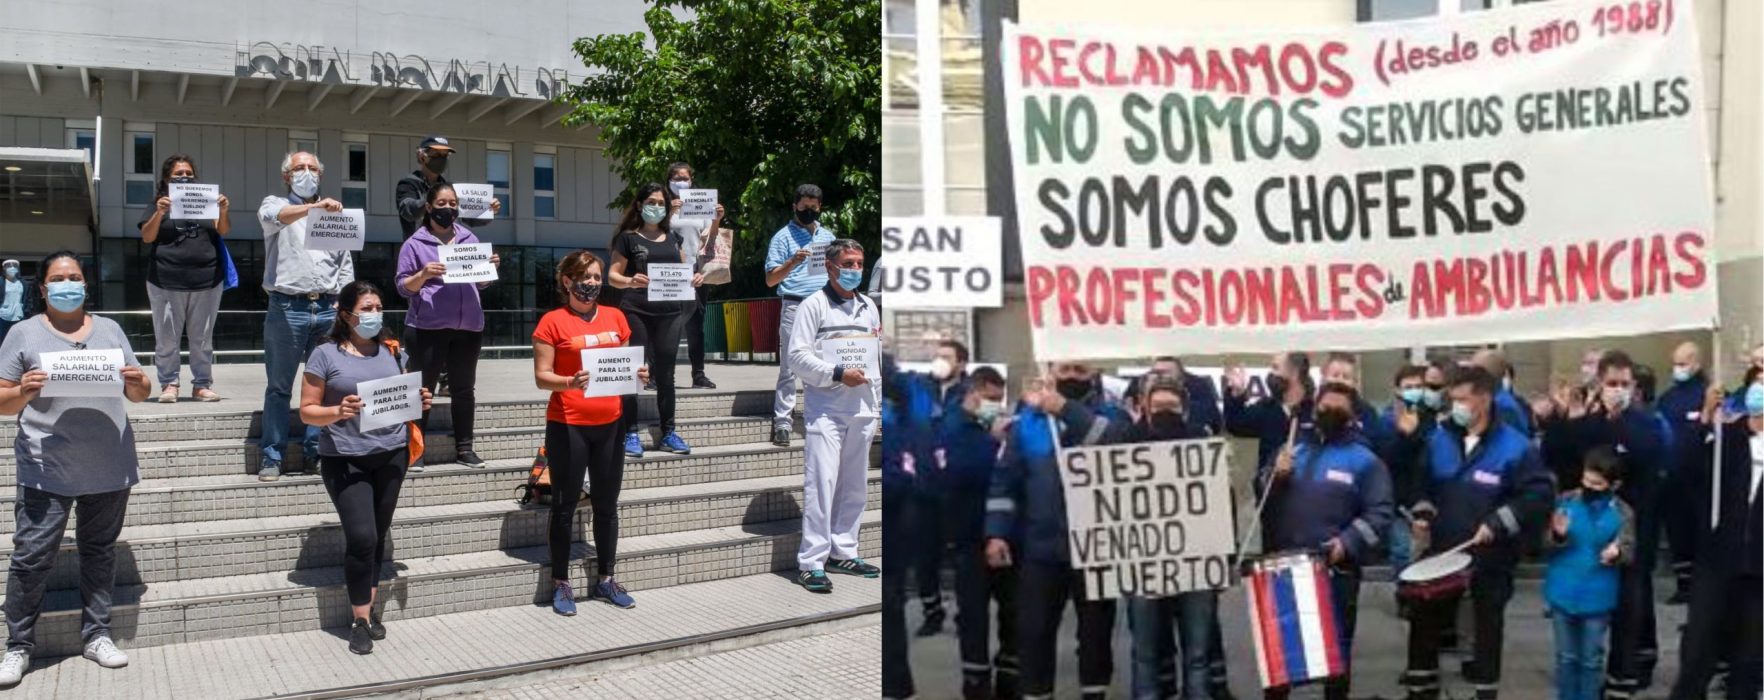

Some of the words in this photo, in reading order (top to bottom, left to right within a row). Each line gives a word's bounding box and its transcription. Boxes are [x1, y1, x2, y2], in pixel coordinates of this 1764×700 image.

[1018, 35, 1354, 98] RECLAMAMOS
[1373, 31, 1478, 85] (desde
[1490, 26, 1521, 57] el
[1528, 18, 1579, 53] año
[1591, 0, 1674, 36] 1988)
[1024, 93, 1098, 164] NO
[1121, 92, 1322, 164] SOMOS
[1338, 96, 1503, 148] SERVICIOS
[1515, 77, 1691, 133] GENERALES
[1037, 174, 1237, 249] SOMOS
[1255, 161, 1525, 244] CHOFERES
[311, 231, 359, 239] EMERGENCIA.
[881, 226, 963, 252] SAN
[446, 254, 487, 262] ESENCIALES
[448, 270, 491, 278] DESCARTABLES
[1028, 263, 1384, 328] PROFESIONALES
[1410, 232, 1707, 319] AMBULANCIAS
[50, 373, 117, 382] EMERGENCIA.
[52, 363, 100, 371] SALARIAL
[102, 363, 116, 371] DE
[372, 384, 408, 396] AUMENTO
[373, 396, 392, 405] PARA
[1066, 446, 1155, 488] SIES
[1170, 442, 1224, 479] 107
[1093, 480, 1207, 524] NODO
[1071, 520, 1186, 564] VENADO
[1089, 555, 1226, 597] TUERTO
